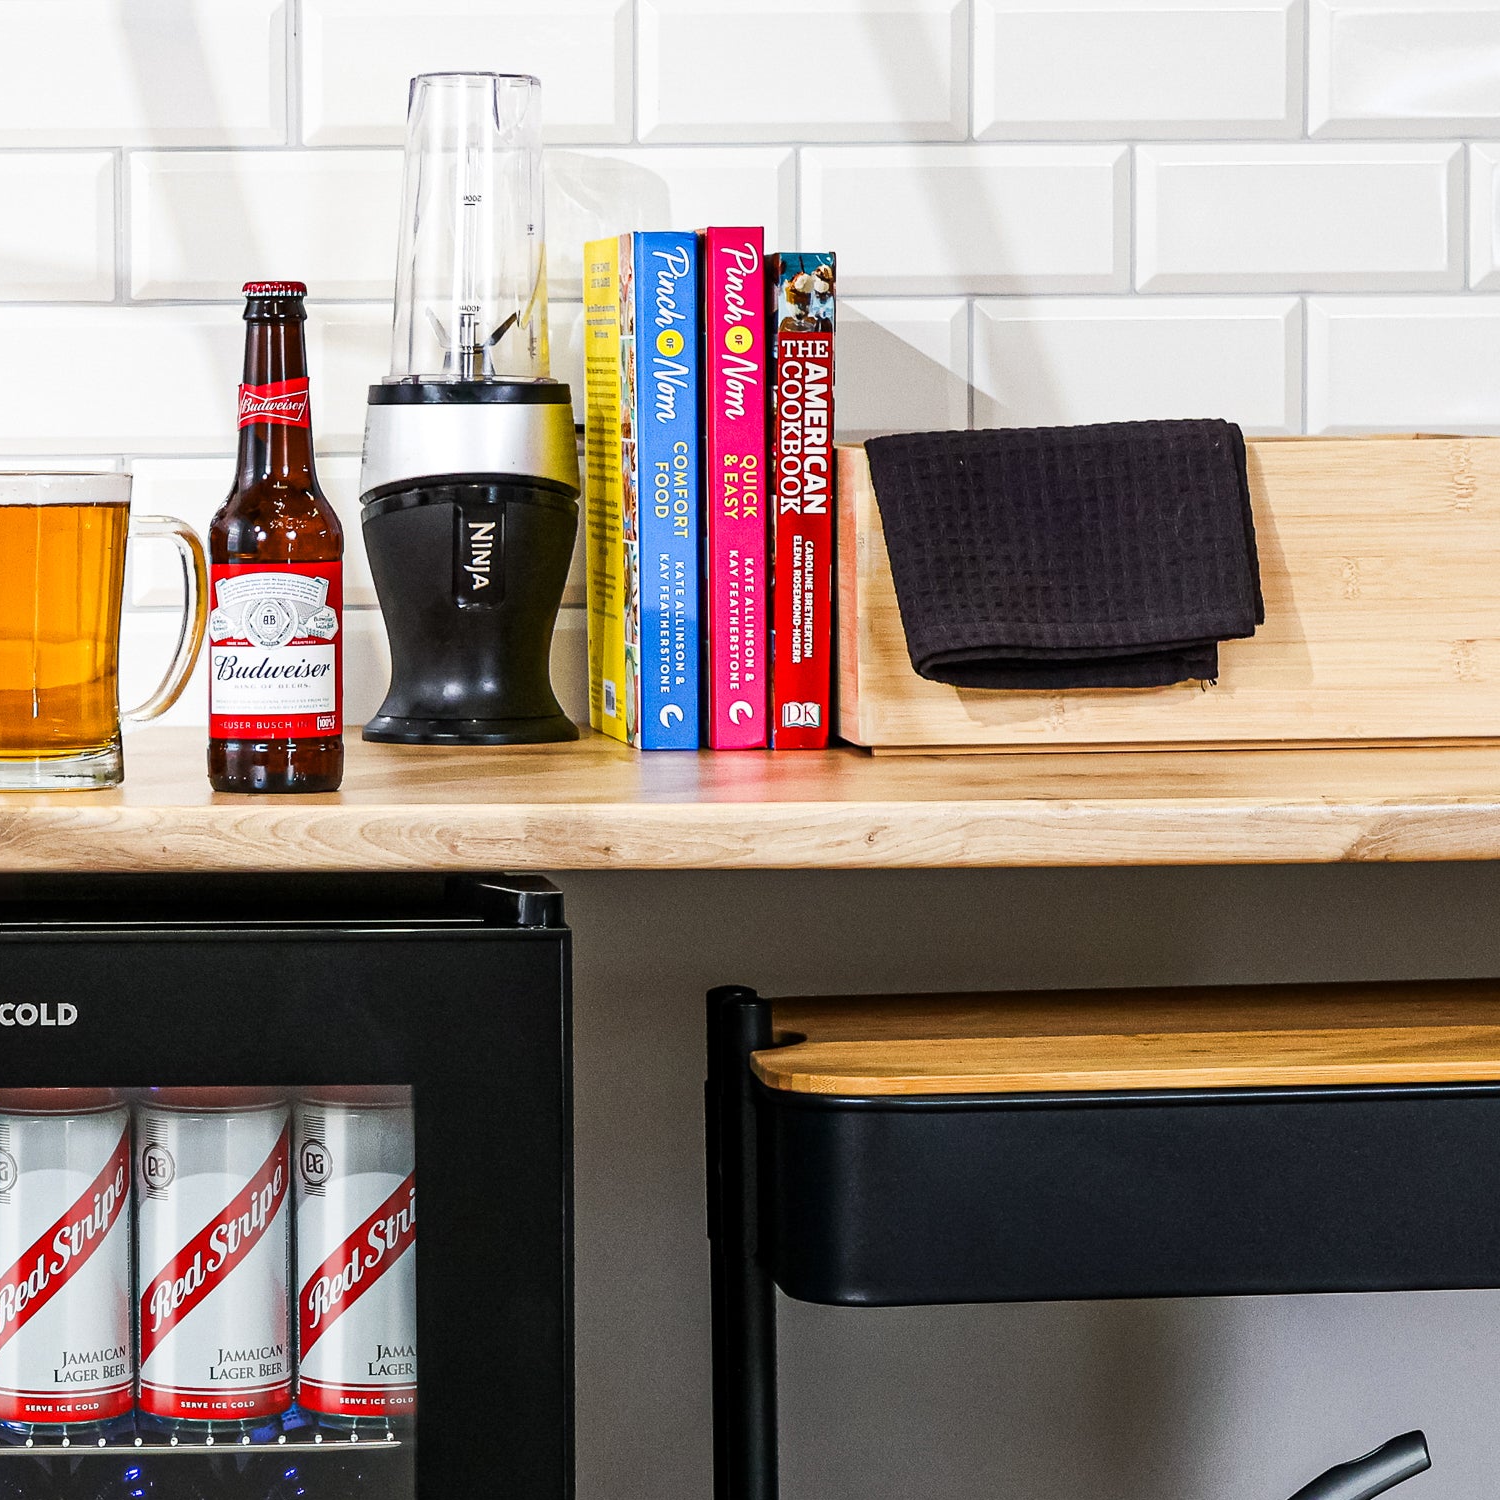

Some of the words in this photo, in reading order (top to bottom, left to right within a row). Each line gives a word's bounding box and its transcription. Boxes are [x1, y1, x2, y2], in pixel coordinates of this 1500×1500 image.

[652, 245, 690, 328] Pinch
[720, 242, 759, 325] Pinch
[666, 338, 674, 349] OF
[735, 334, 743, 345] OF
[781, 340, 829, 358] THE
[241, 397, 304, 414] Budweiser
[652, 357, 690, 424] Nom
[721, 354, 759, 421] Nom
[724, 454, 738, 466] &
[780, 361, 803, 514] COOKBOOK
[803, 361, 828, 514] AMERICAN
[654, 462, 670, 519] FOOD
[673, 441, 689, 538] COMFORT
[724, 472, 739, 520] EASY
[740, 455, 758, 518] QUICK
[463, 521, 496, 591] NINJA
[659, 553, 669, 580] KAY
[675, 561, 685, 596] KATE
[729, 550, 739, 577] KAY
[744, 557, 754, 593] KATE
[793, 535, 802, 568] ELENA
[804, 540, 814, 591] CAROLINE
[659, 585, 670, 693] FEATHERSTONE
[675, 600, 686, 671] ALLINSON
[729, 582, 740, 690] FEATHERSTONE
[744, 597, 755, 668] ALLINSON
[792, 569, 802, 664] ROSEMOND-HOERR
[804, 592, 814, 658] BRETHERTON
[214, 655, 330, 681] Budweiser
[675, 677, 686, 685] &
[745, 673, 755, 682] &
[787, 705, 817, 723] DK
[50, 1166, 124, 1274] Stripe
[150, 1251, 206, 1332] Red
[206, 1165, 282, 1272] Stripe
[308, 1247, 364, 1329] Red
[25, 1404, 53, 1412] SERVE
[56, 1404, 72, 1412] ICE
[76, 1403, 99, 1411] COLD
[180, 1401, 208, 1409] SERVE
[212, 1401, 228, 1409] ICE
[231, 1401, 255, 1409] COLD
[339, 1397, 367, 1405] SERVE
[389, 1397, 414, 1405] COLD
